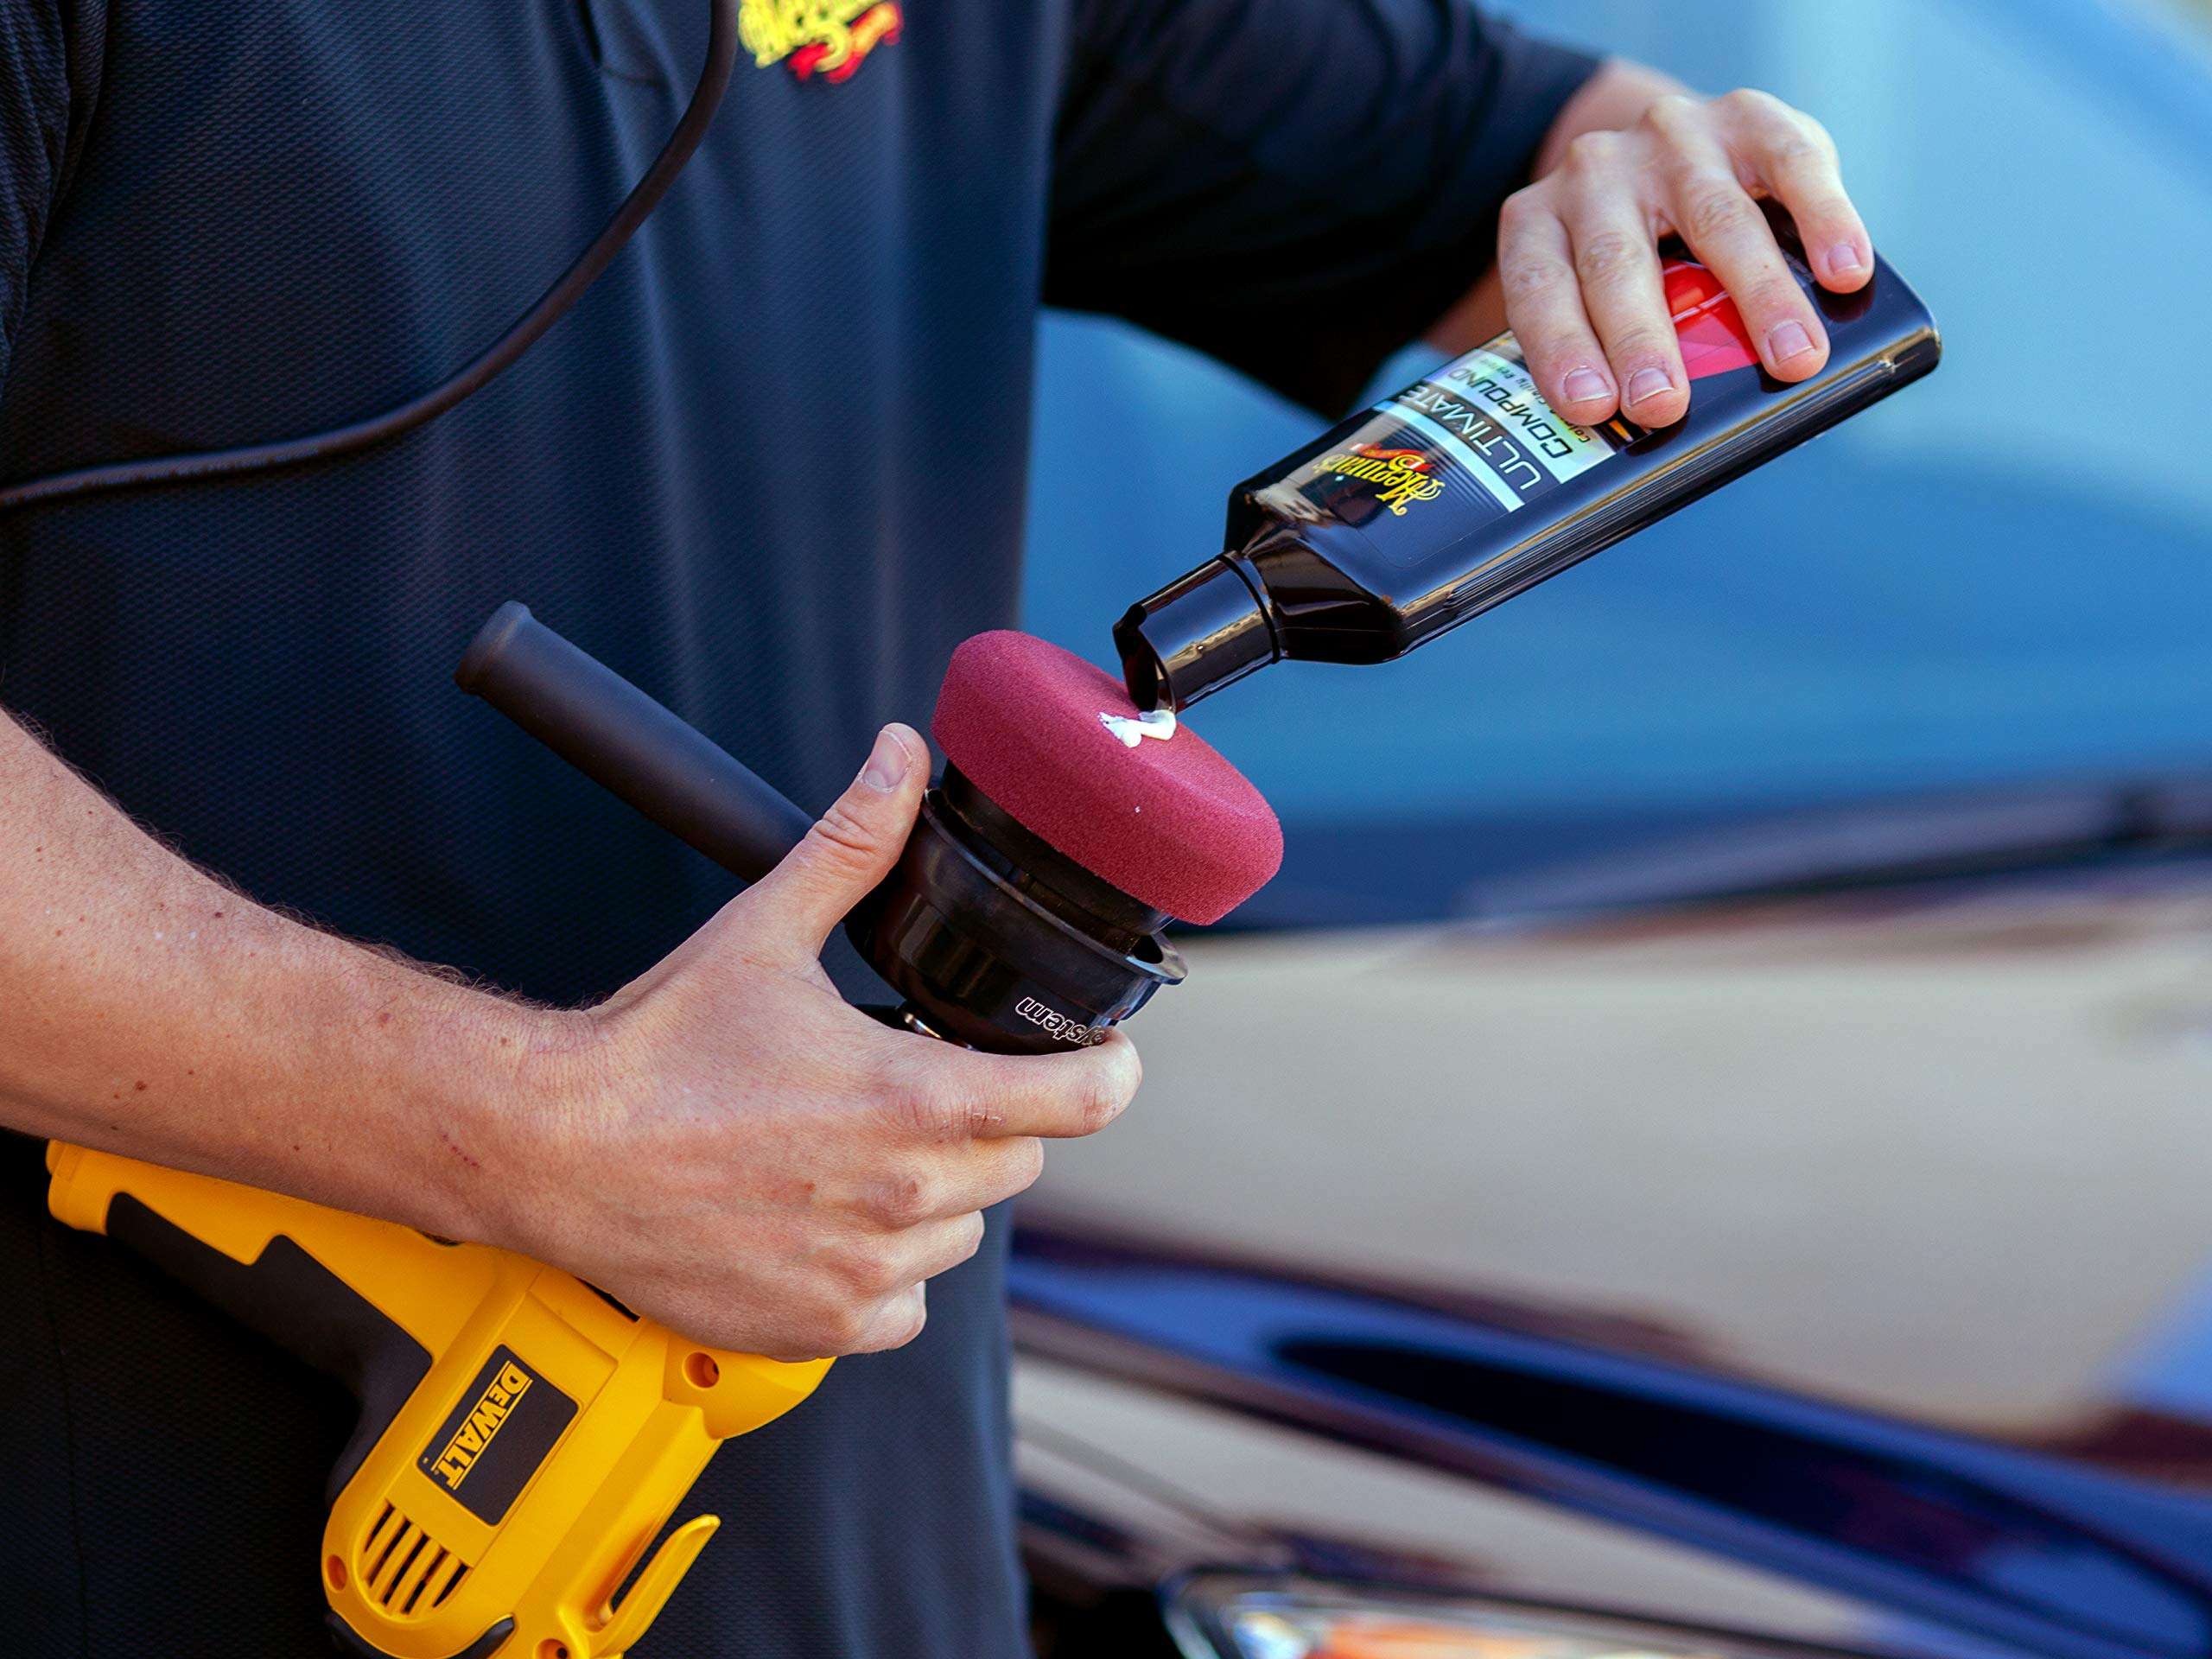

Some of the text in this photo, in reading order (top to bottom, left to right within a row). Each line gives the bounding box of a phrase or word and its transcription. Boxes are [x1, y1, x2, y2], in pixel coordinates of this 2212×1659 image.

[1399, 385, 1541, 490] ULTIMATE
[1449, 366, 1573, 458] COMPOUND
[435, 1362, 531, 1489] DEWALT
